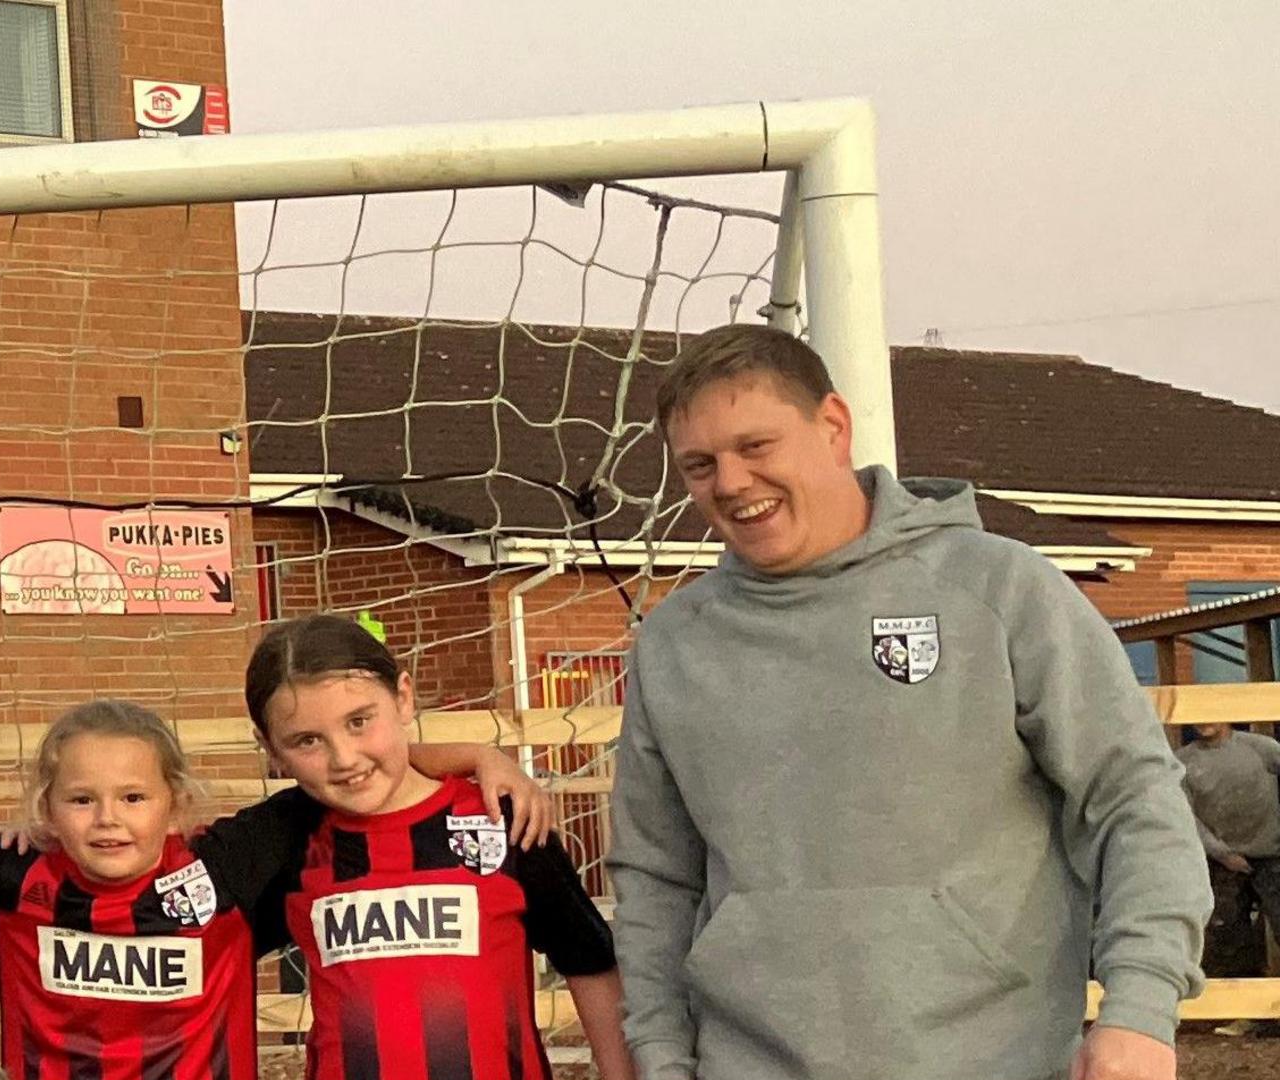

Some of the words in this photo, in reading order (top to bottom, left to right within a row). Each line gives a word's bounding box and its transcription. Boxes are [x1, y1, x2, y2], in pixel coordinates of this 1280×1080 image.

[126, 557, 154, 578] Go
[53, 584, 99, 601] know
[101, 586, 129, 604] you
[132, 587, 171, 601] want
[324, 896, 462, 950] MANE
[53, 939, 187, 987] MANE
